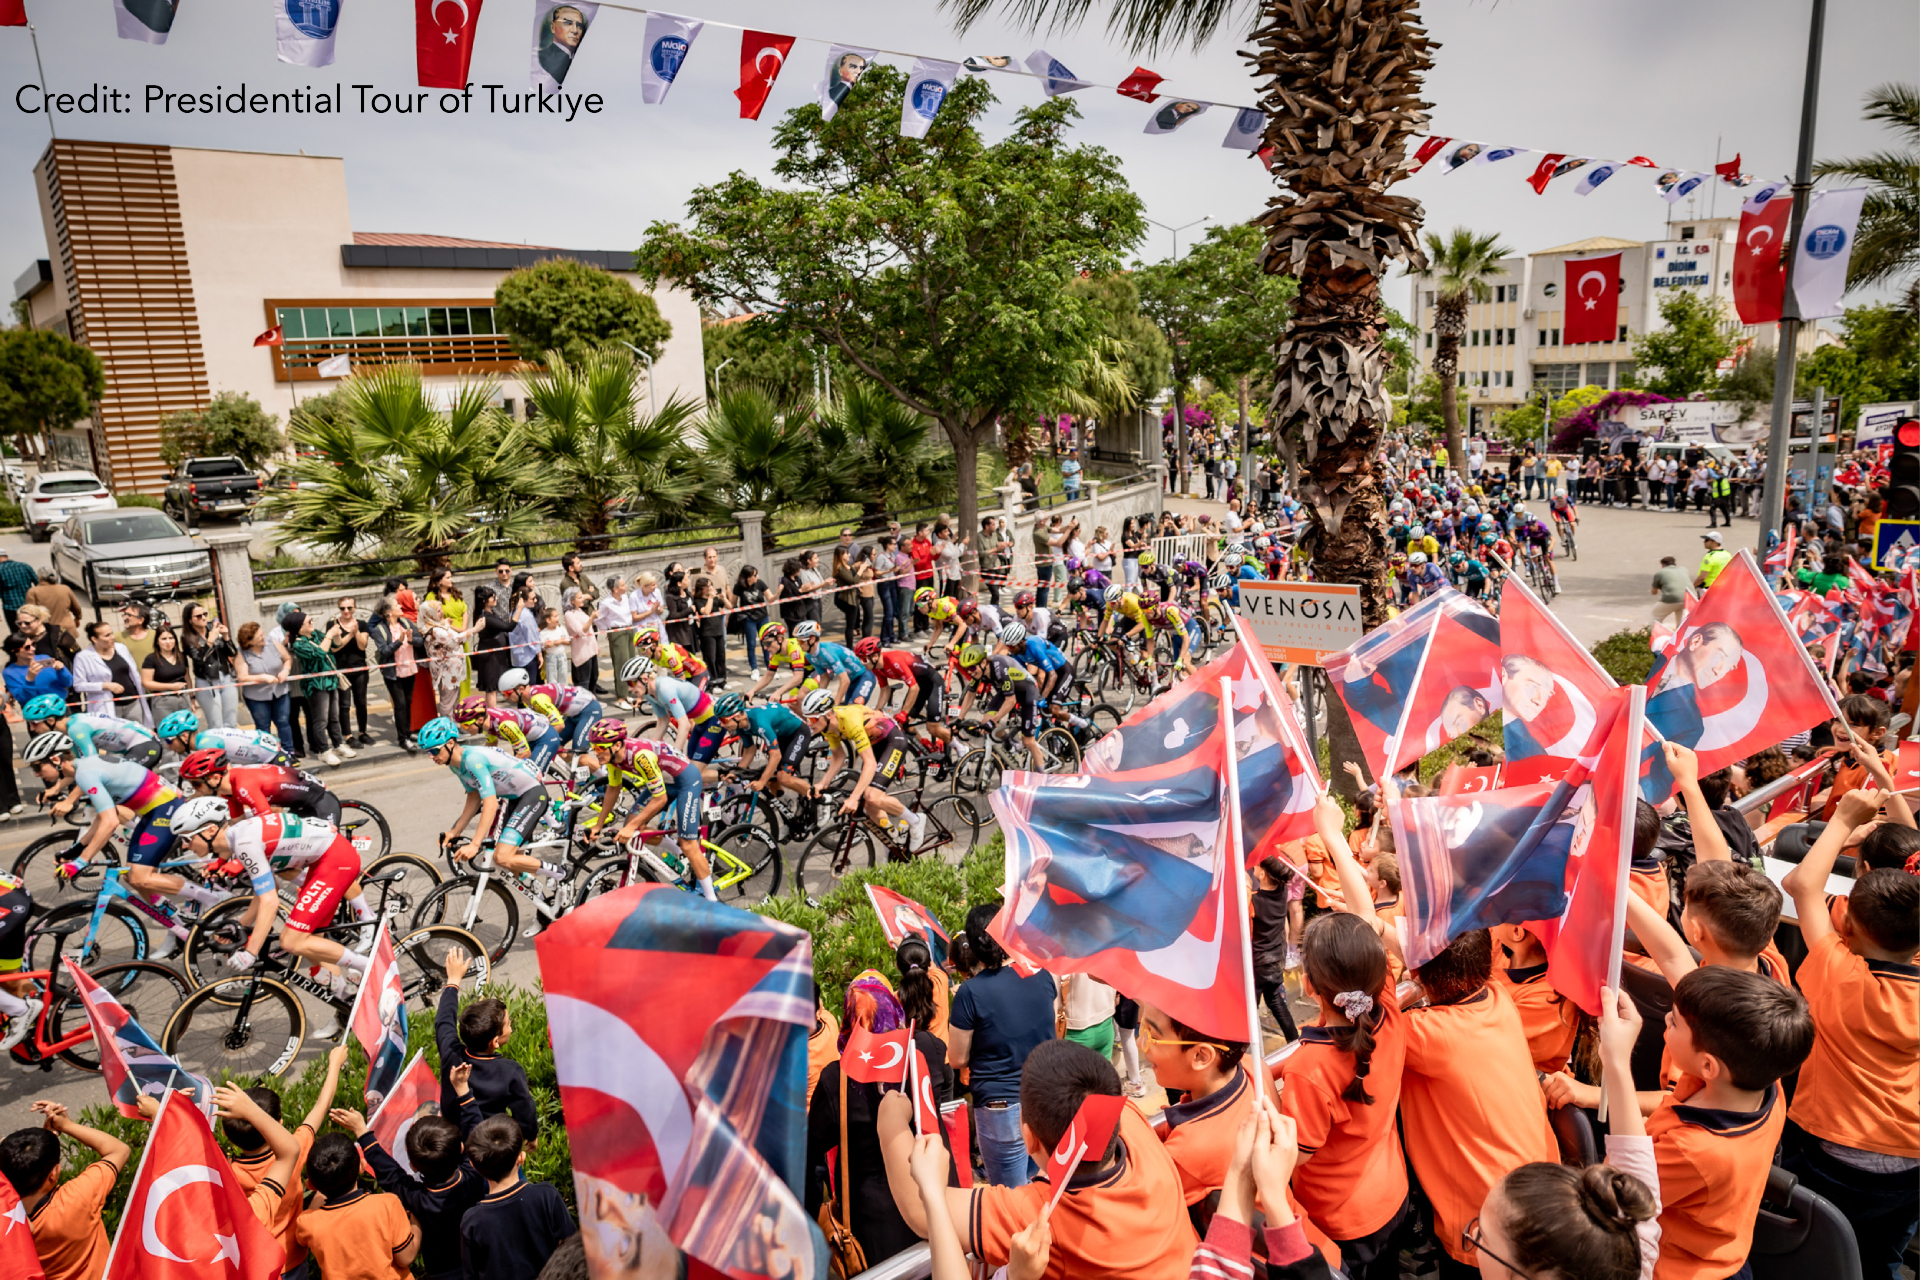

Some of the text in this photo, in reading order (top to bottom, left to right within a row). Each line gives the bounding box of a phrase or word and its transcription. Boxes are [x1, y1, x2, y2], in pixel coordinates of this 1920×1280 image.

[1244, 595, 1356, 622] VENOSA
[239, 851, 259, 876] solo
[296, 880, 326, 912] POLTI
[308, 887, 334, 914] KOMETA
[278, 968, 336, 1003] AURUM
